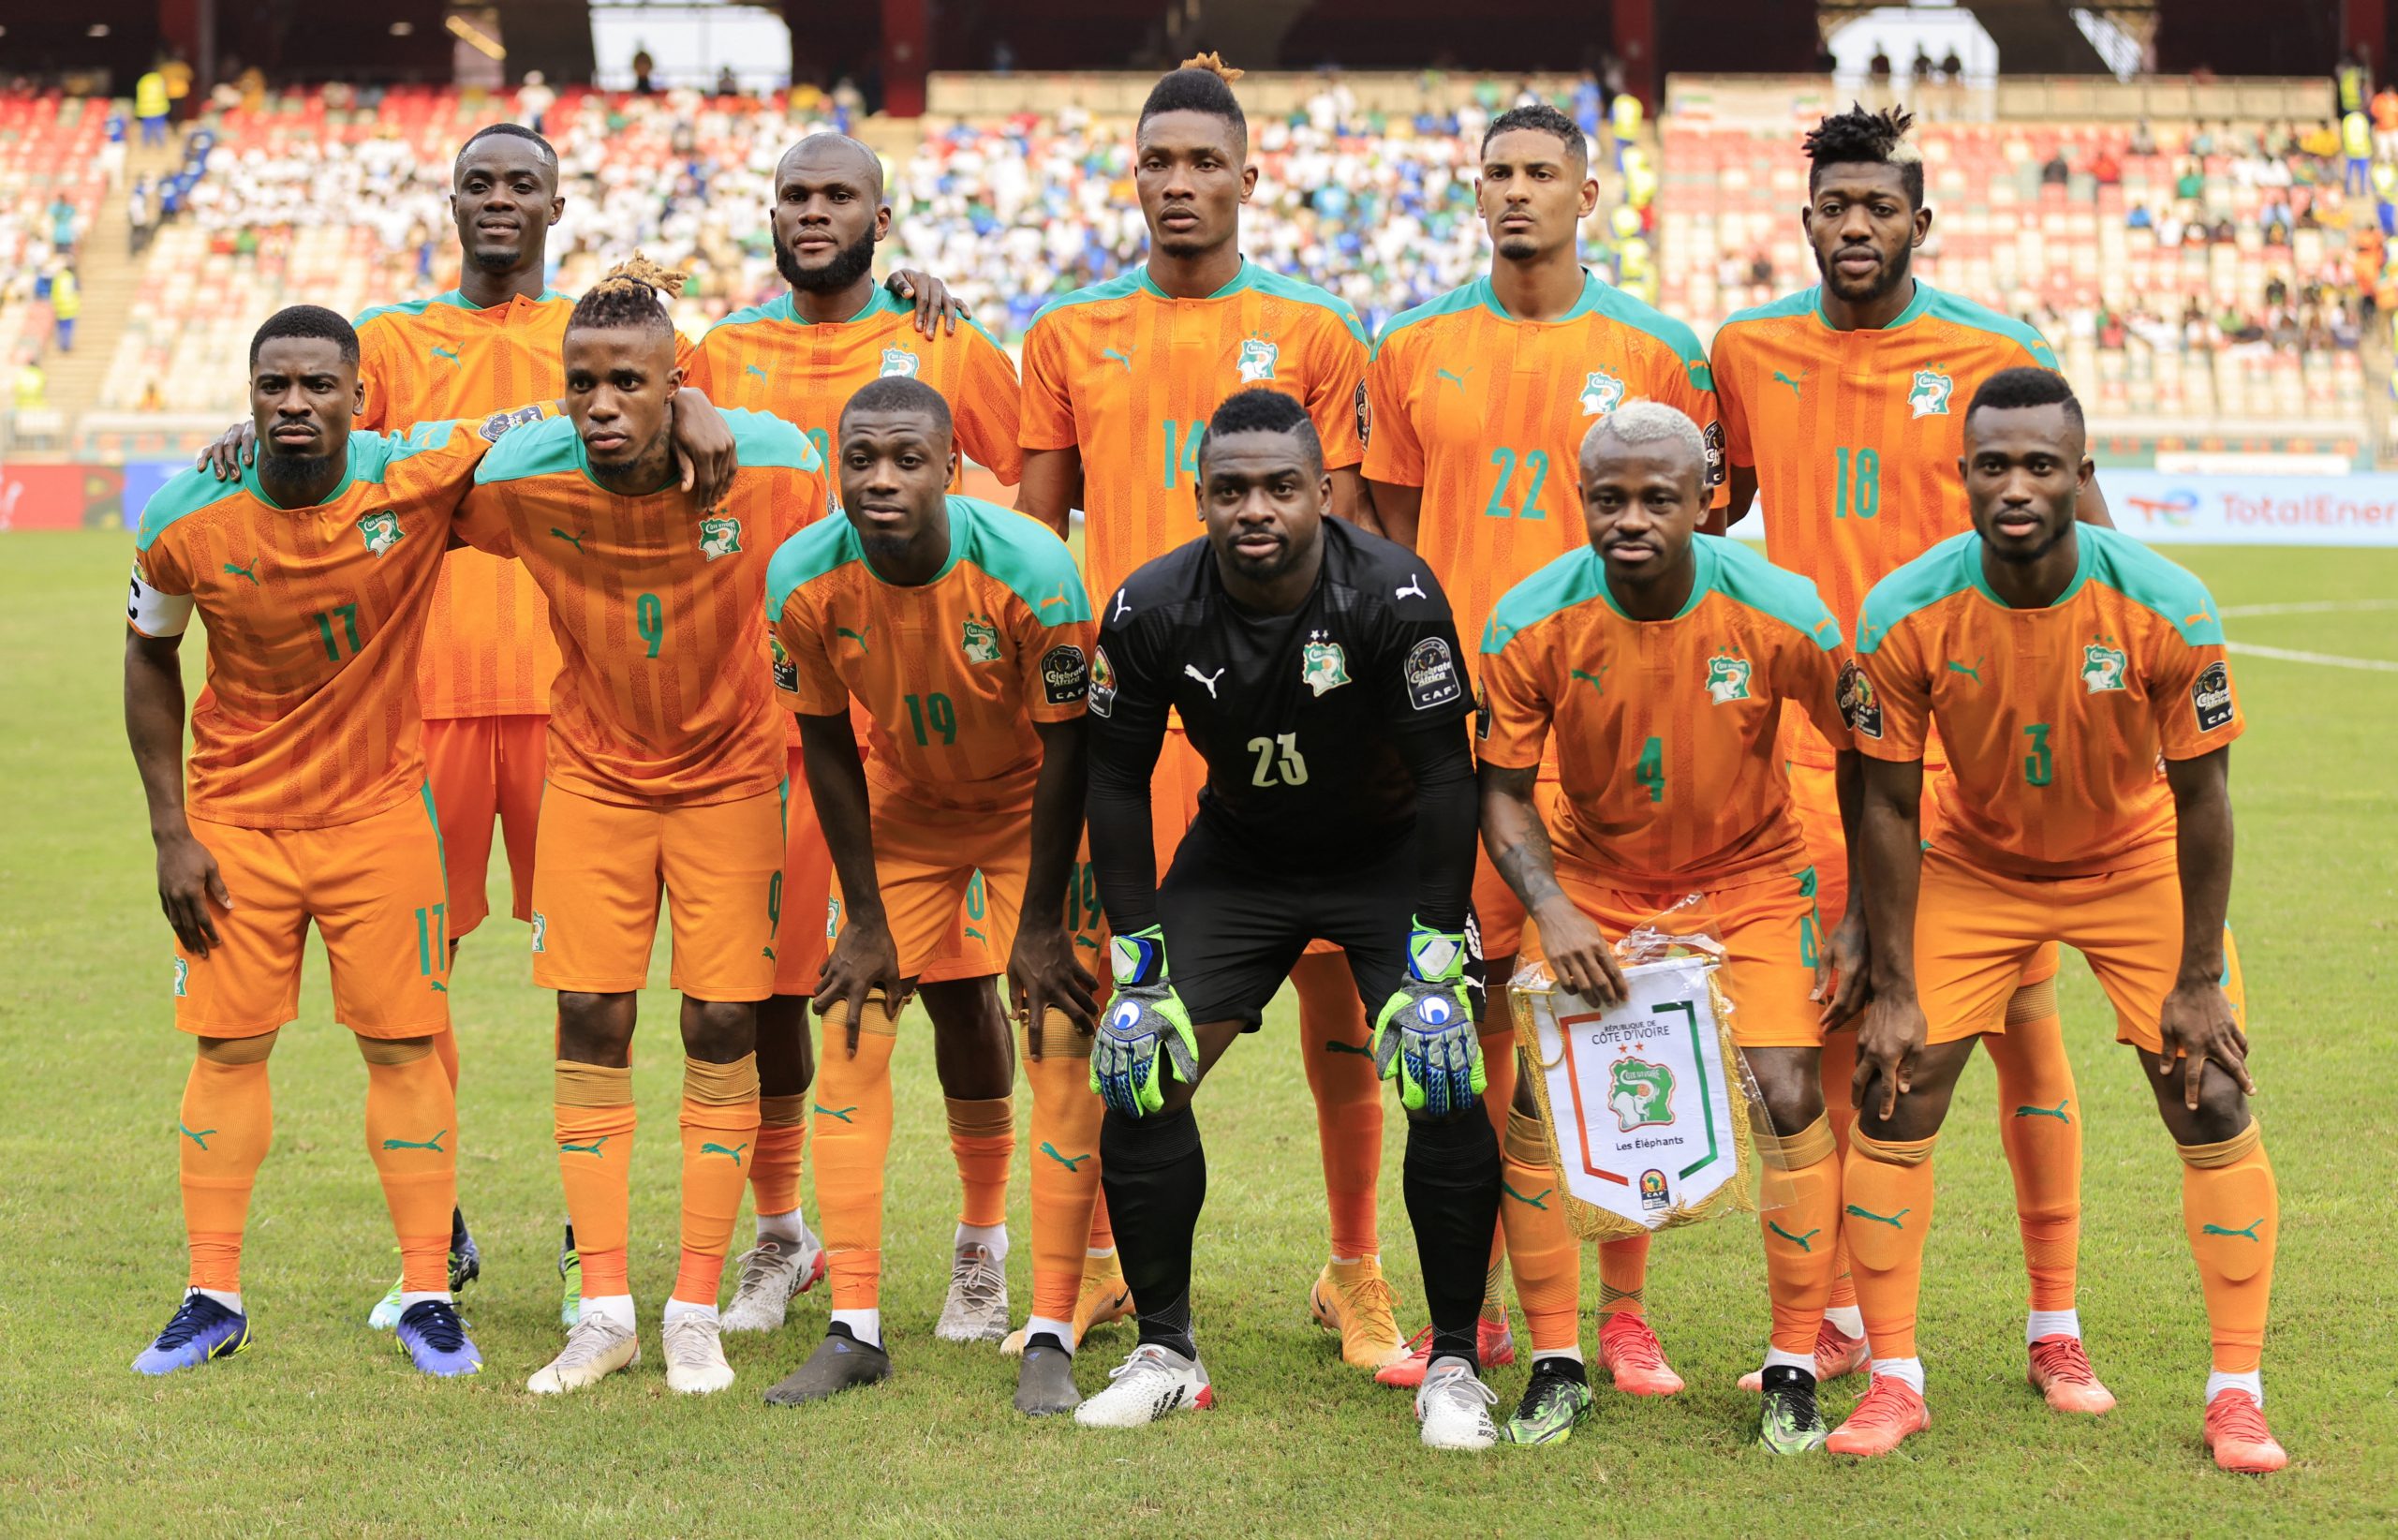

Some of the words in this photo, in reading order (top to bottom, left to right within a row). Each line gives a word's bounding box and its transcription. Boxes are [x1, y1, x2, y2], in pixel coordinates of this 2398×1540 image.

[1162, 420, 1206, 488] 14
[1484, 447, 1549, 520] 22
[1835, 447, 1880, 518] 18
[313, 602, 362, 661] 17
[637, 592, 663, 659] 9
[904, 692, 956, 746] 19
[1056, 687, 1085, 700] CAF
[1421, 686, 1453, 702] CAF
[1247, 732, 1309, 787] 23
[1636, 736, 1665, 803] 4
[2023, 723, 2052, 788] 3
[768, 869, 782, 940] 9
[1069, 862, 1103, 931] 19
[415, 903, 445, 976] 17
[1591, 1031, 1621, 1044] CÔTE
[1624, 1026, 1670, 1041] D'IVOIRE
[1604, 1021, 1645, 1032] RÉPUBLIQUE
[1616, 1142, 1633, 1151] Les
[1635, 1136, 1684, 1150] Éléphants
